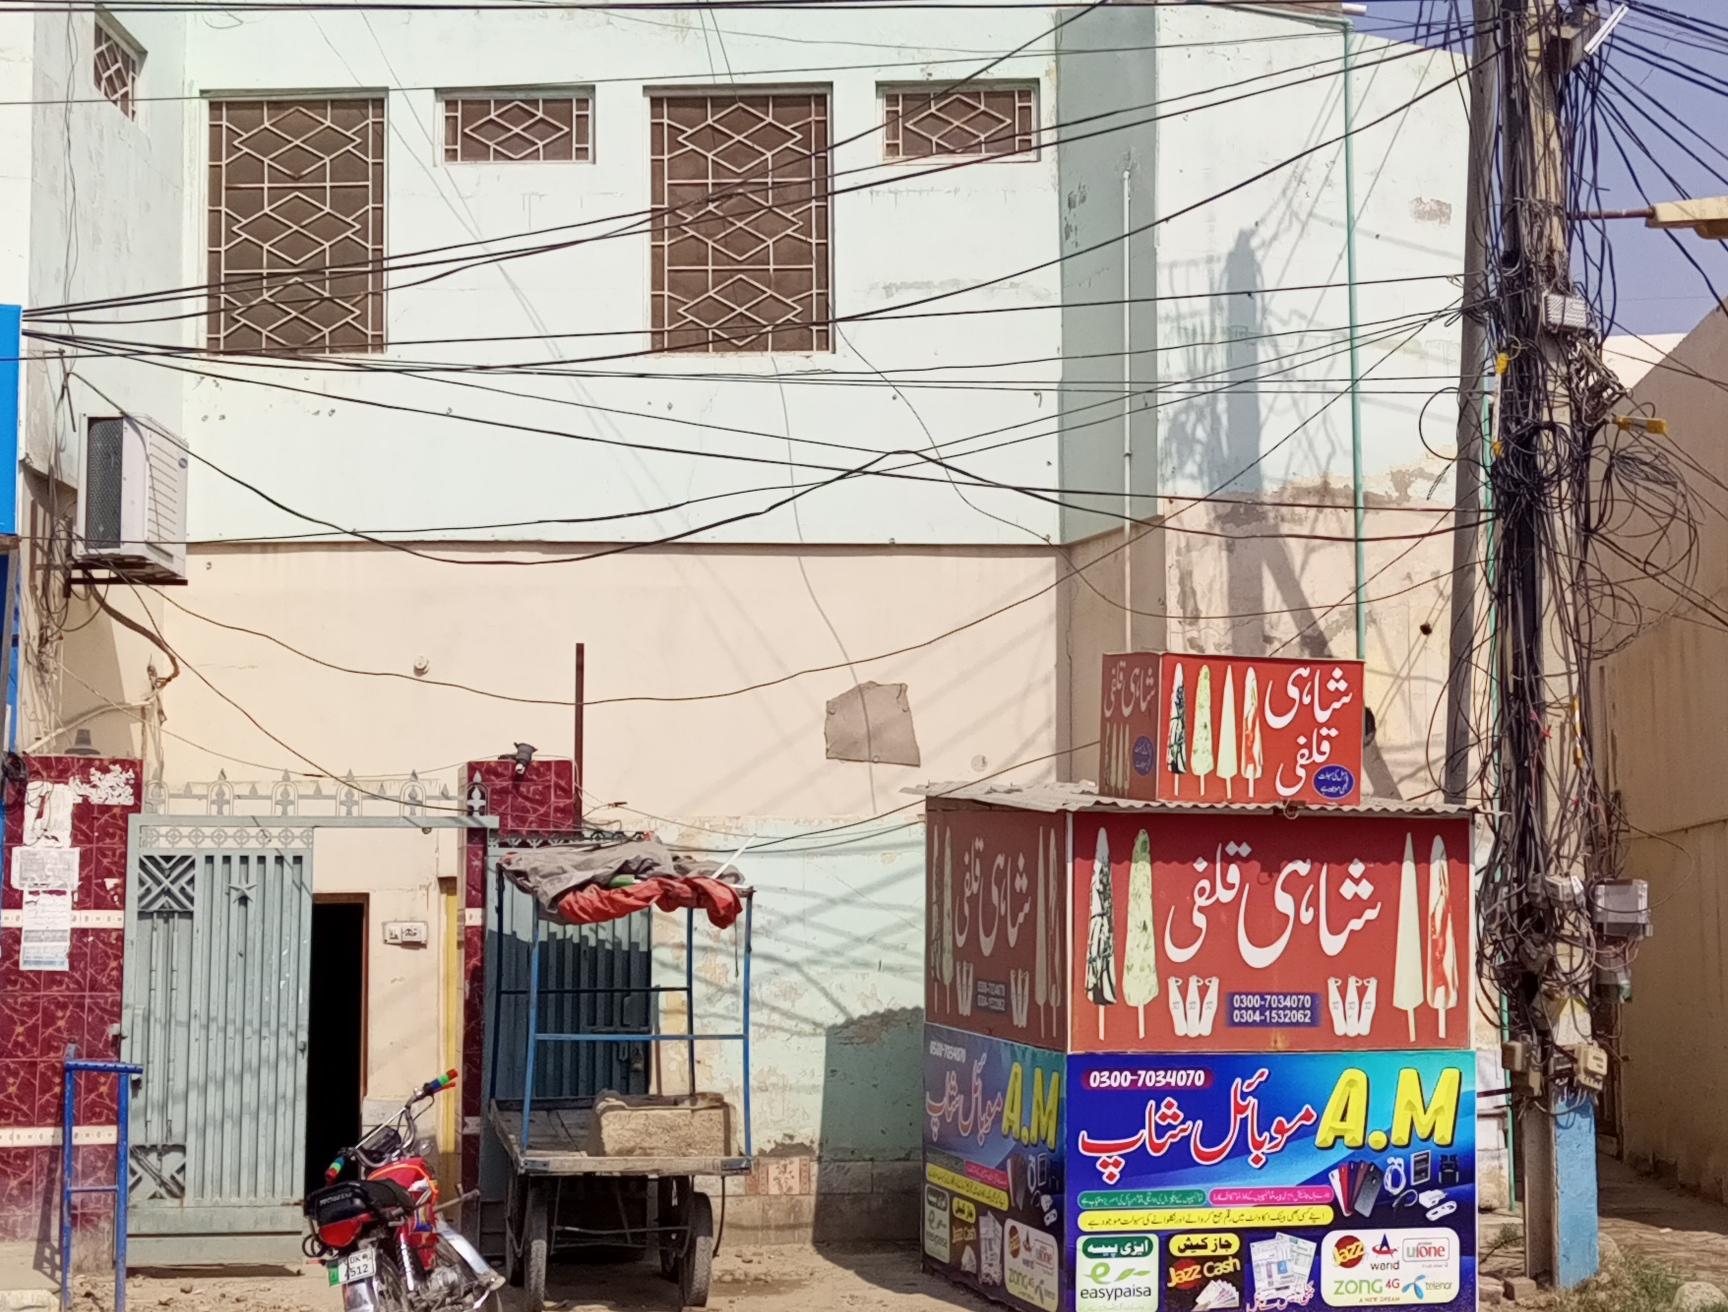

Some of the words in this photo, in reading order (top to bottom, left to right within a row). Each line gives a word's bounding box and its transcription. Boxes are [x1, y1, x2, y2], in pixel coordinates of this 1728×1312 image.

[1104, 660, 1126, 718] قلفی
[1122, 666, 1156, 717] شاہی
[1264, 666, 1352, 729] شاہی
[1275, 726, 1340, 797] قلفی
[955, 837, 984, 949] قلفی
[978, 852, 1032, 957] شاہی
[1164, 840, 1252, 963] قلفی
[1237, 857, 1382, 969] شاہی
[1233, 995, 1312, 1009] 0300-7034070
[1233, 1010, 1312, 1024] 0304-1532062
[1089, 1069, 1205, 1088] 0300-7034070
[1001, 1062, 1060, 1151] A.M
[1190, 1068, 1317, 1168] موبائل
[1314, 1067, 1462, 1150] A.M
[1078, 1097, 1193, 1185] شاپ
[1177, 1236, 1208, 1253] کیش
[1212, 1237, 1233, 1252] جاز
[1333, 1241, 1366, 1267] Jazz
[1370, 1261, 1400, 1270] warid
[1080, 1286, 1152, 1301] easypaisa
[1167, 1265, 1201, 1288] Jazz
[1204, 1256, 1240, 1277] Cash
[1386, 1278, 1400, 1289] 4G
